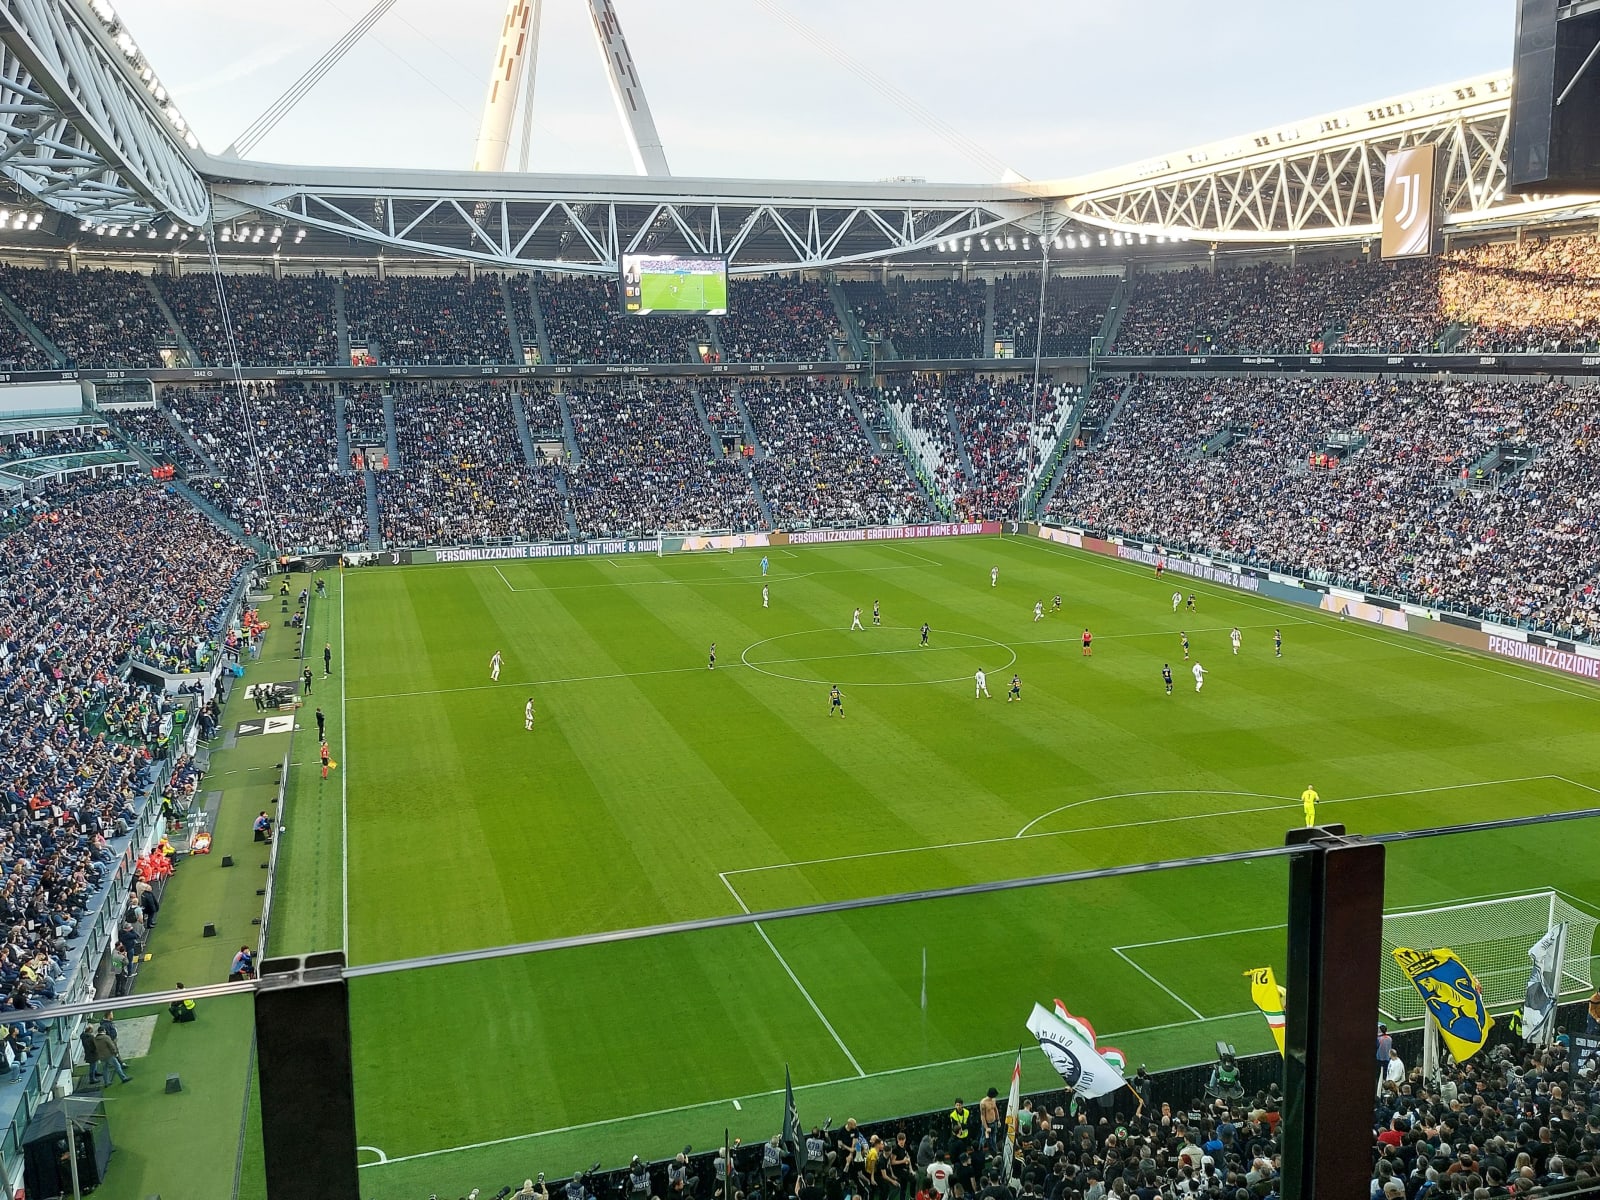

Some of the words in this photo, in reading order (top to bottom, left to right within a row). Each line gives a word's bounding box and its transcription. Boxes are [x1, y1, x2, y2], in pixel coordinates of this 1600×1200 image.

[788, 529, 865, 544] PERSONALIZZAZIONE
[867, 527, 904, 540] GRATUITA
[904, 527, 915, 538] SU
[916, 526, 929, 537] KIT
[930, 525, 951, 536] HOME
[952, 525, 959, 534] &
[960, 524, 983, 534] AWAY
[436, 546, 528, 562] PERSONALIZZAZIONE
[530, 544, 572, 558] GRATUITA
[574, 544, 586, 554] SU
[588, 542, 602, 554] KIT
[602, 542, 627, 554] HOME
[628, 540, 636, 552] &
[1168, 560, 1195, 574] GRATUITA
[1194, 566, 1203, 576] SU
[1203, 567, 1214, 579] KIT
[1214, 569, 1232, 584] HOME
[1232, 574, 1239, 586] &
[1240, 576, 1260, 591] AWAY
[1488, 636, 1600, 678] PERSONALIZZAZIONE
